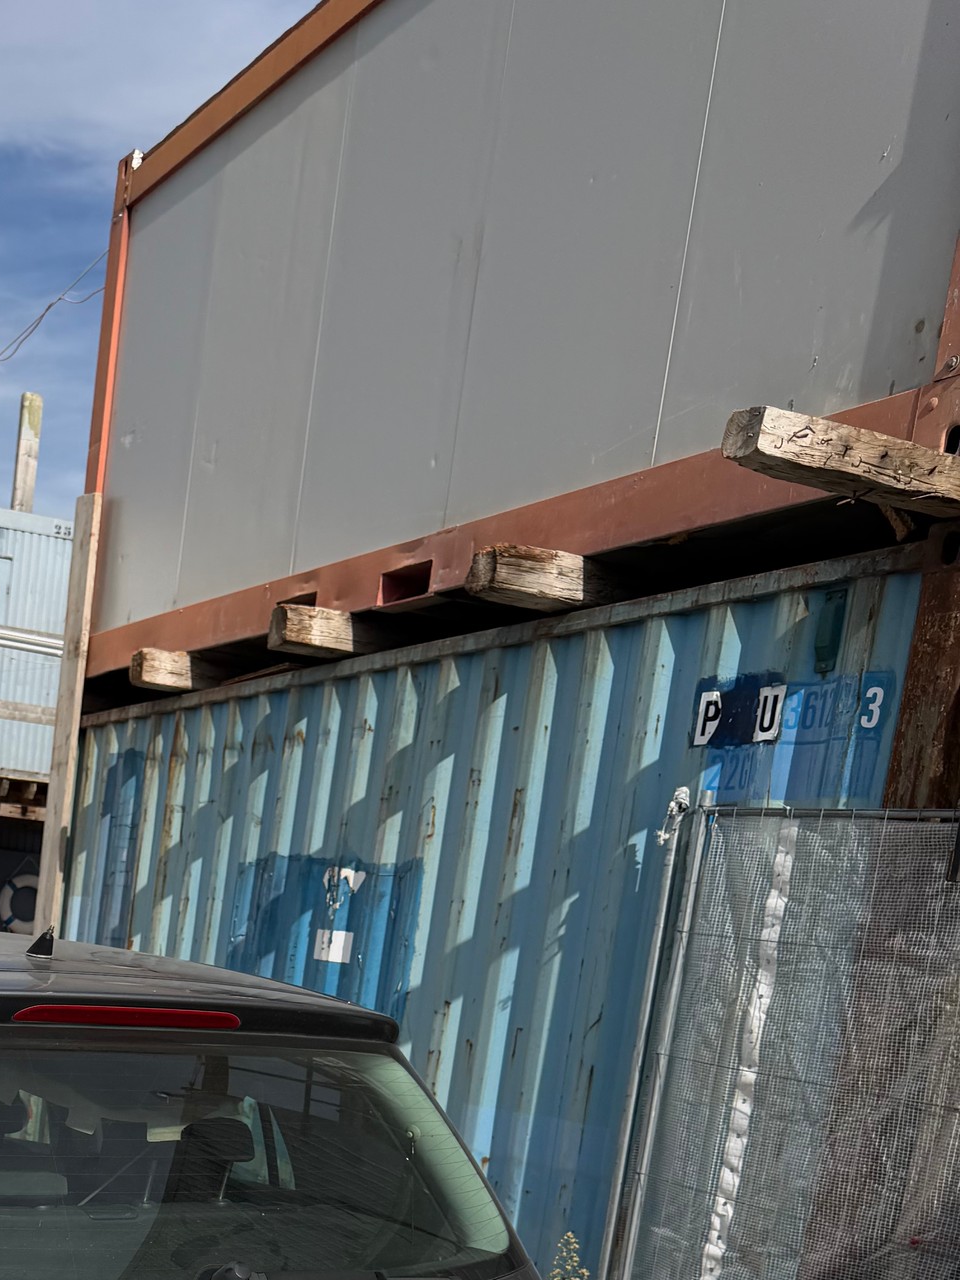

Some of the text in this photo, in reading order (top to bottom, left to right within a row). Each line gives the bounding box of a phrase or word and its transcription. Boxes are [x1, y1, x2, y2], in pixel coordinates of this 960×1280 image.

[700, 700, 722, 737] P
[759, 694, 780, 733] U
[860, 686, 885, 729] 3
